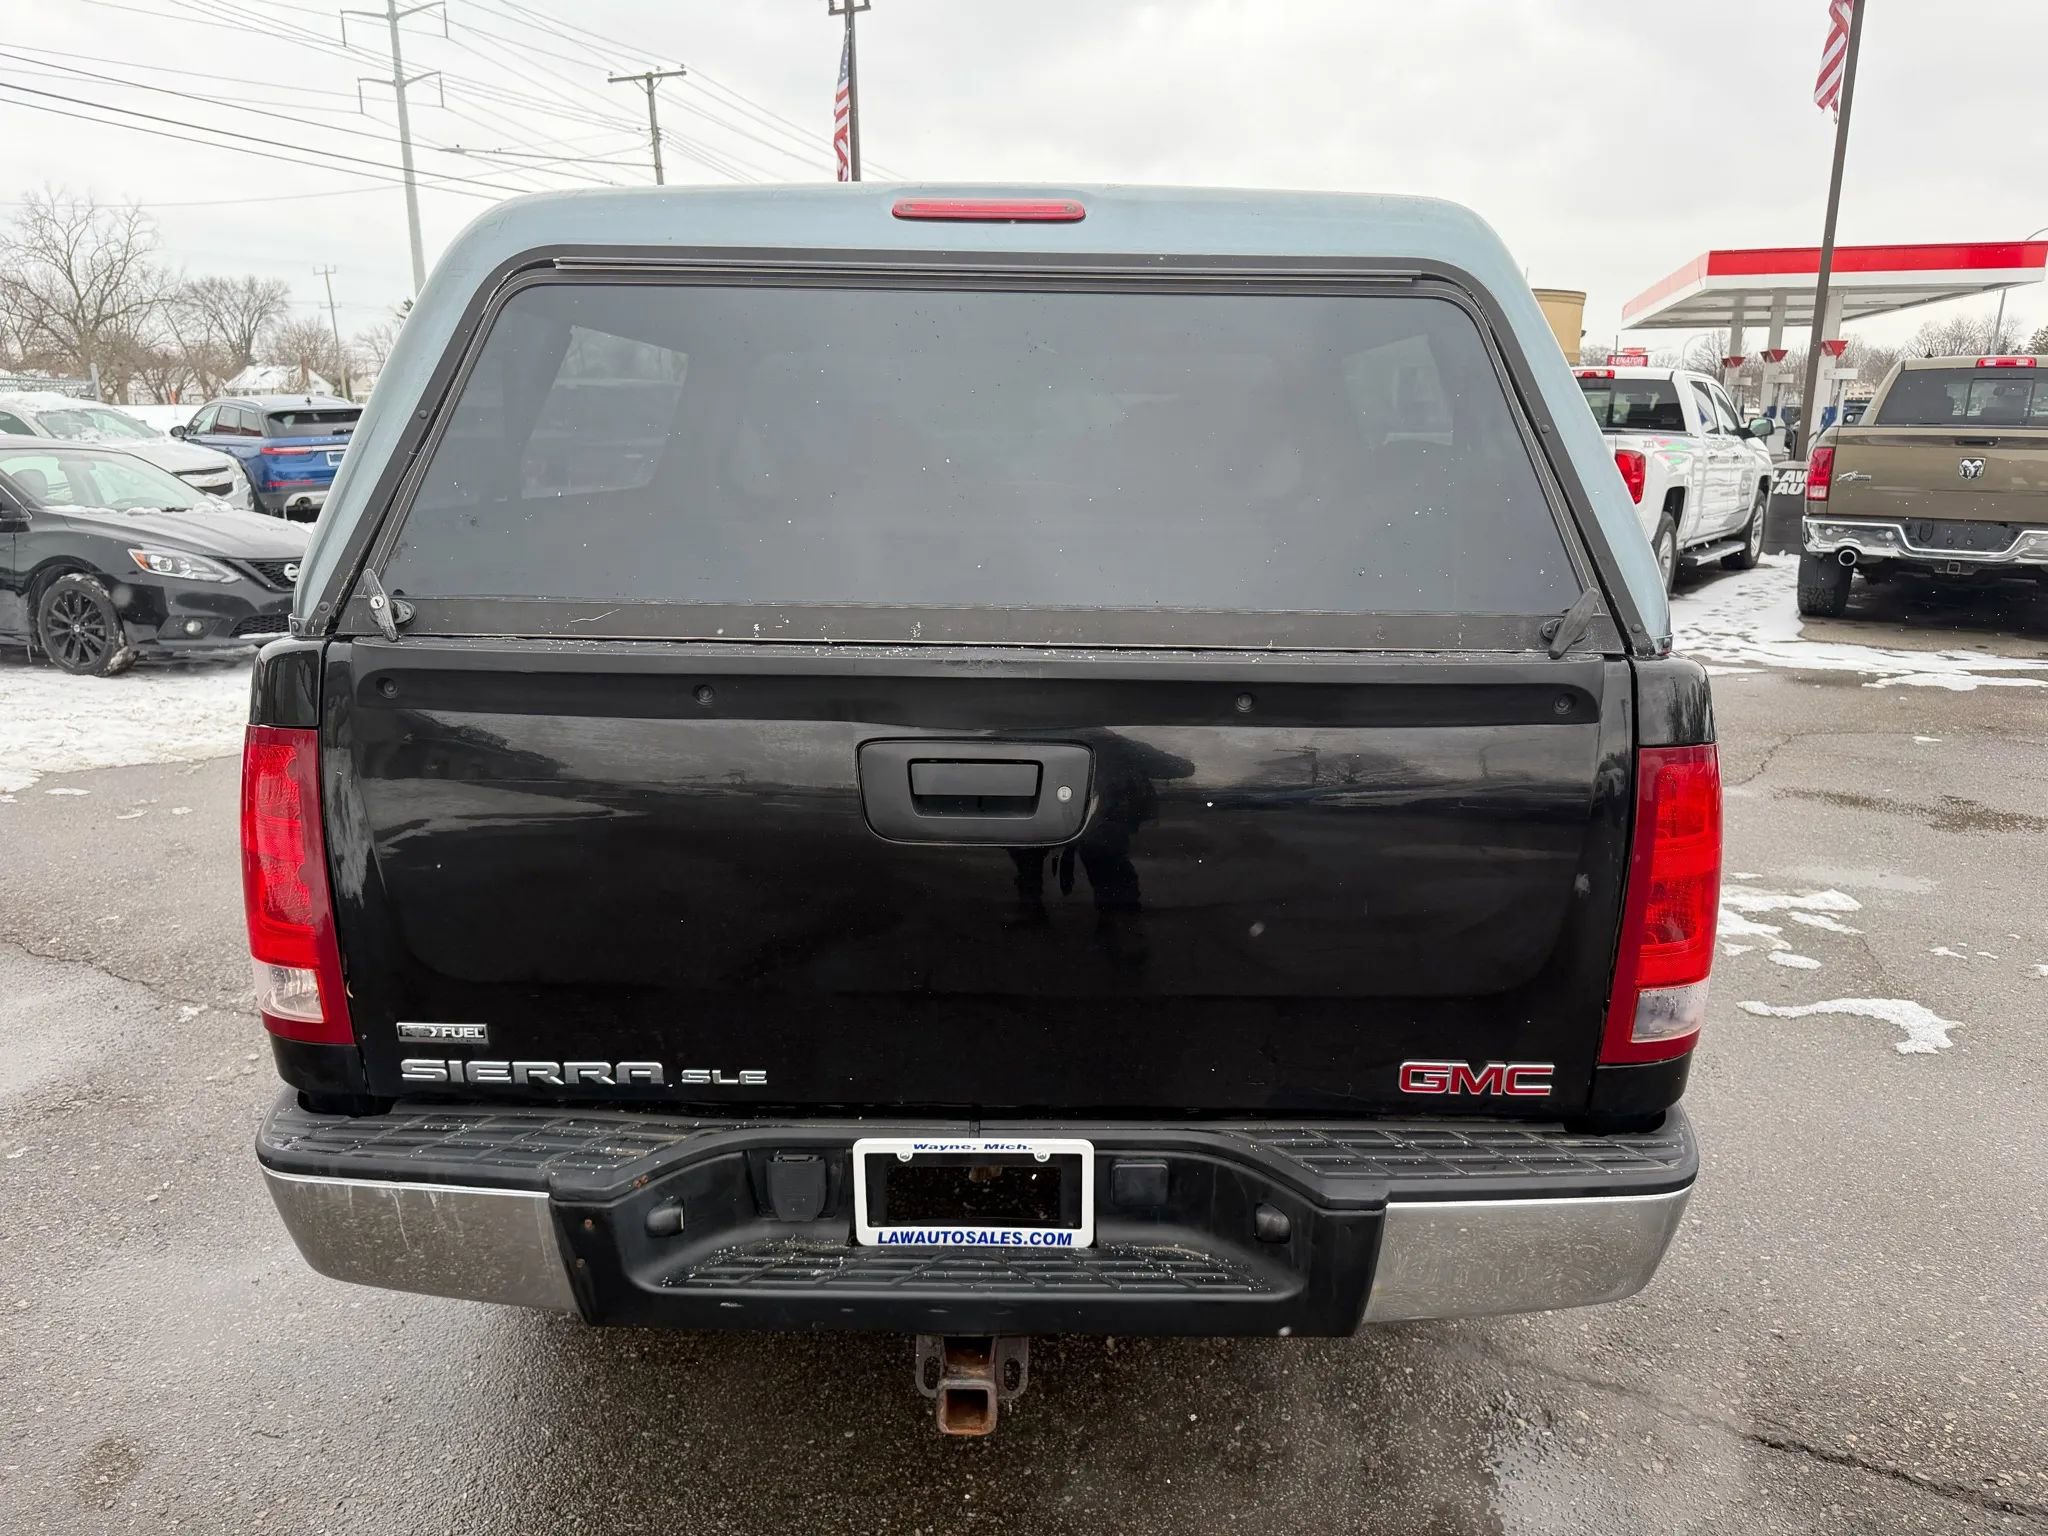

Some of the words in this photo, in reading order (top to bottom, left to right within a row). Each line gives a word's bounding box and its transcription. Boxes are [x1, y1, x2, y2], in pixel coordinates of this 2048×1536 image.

[400, 1059, 665, 1085] SIERRA
[681, 1069, 767, 1085] SLE
[1399, 1059, 1555, 1096] GMC
[913, 1143, 977, 1151] Wayne,
[877, 1231, 1073, 1246] LAWAUTOSALES.COM
